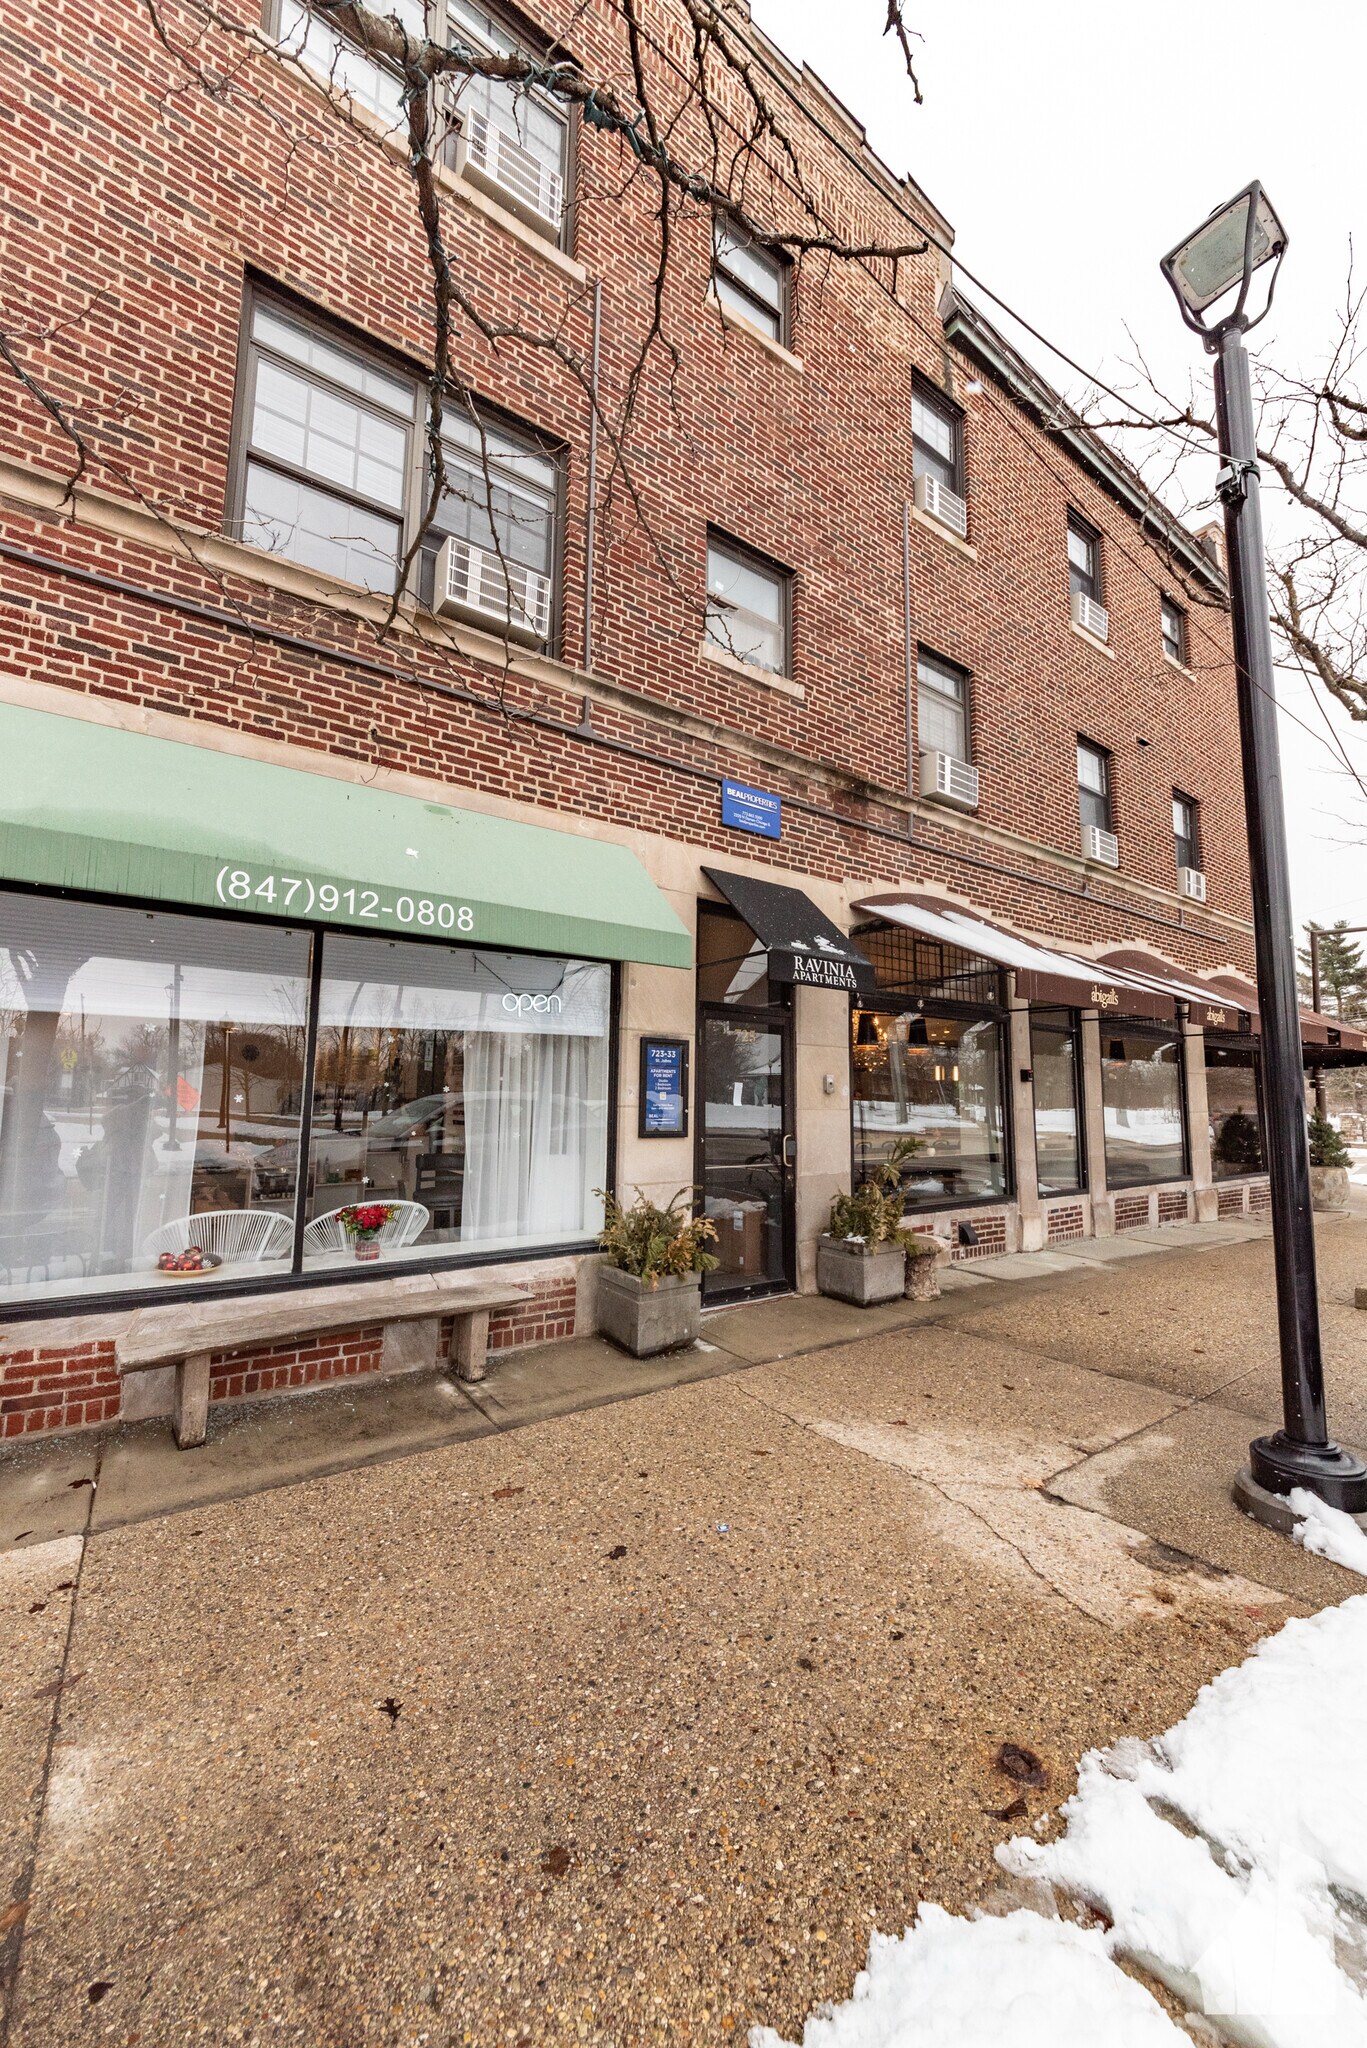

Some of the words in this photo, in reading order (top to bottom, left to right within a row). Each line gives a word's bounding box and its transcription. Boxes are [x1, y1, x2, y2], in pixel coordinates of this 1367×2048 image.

[727, 787, 778, 810] BEALPROPERTIES
[216, 866, 474, 932] (847)912-0808
[794, 955, 855, 979] RAVINIA
[792, 970, 857, 988] APARTMENTS
[502, 993, 561, 1017] open
[651, 1049, 676, 1058] 723-33
